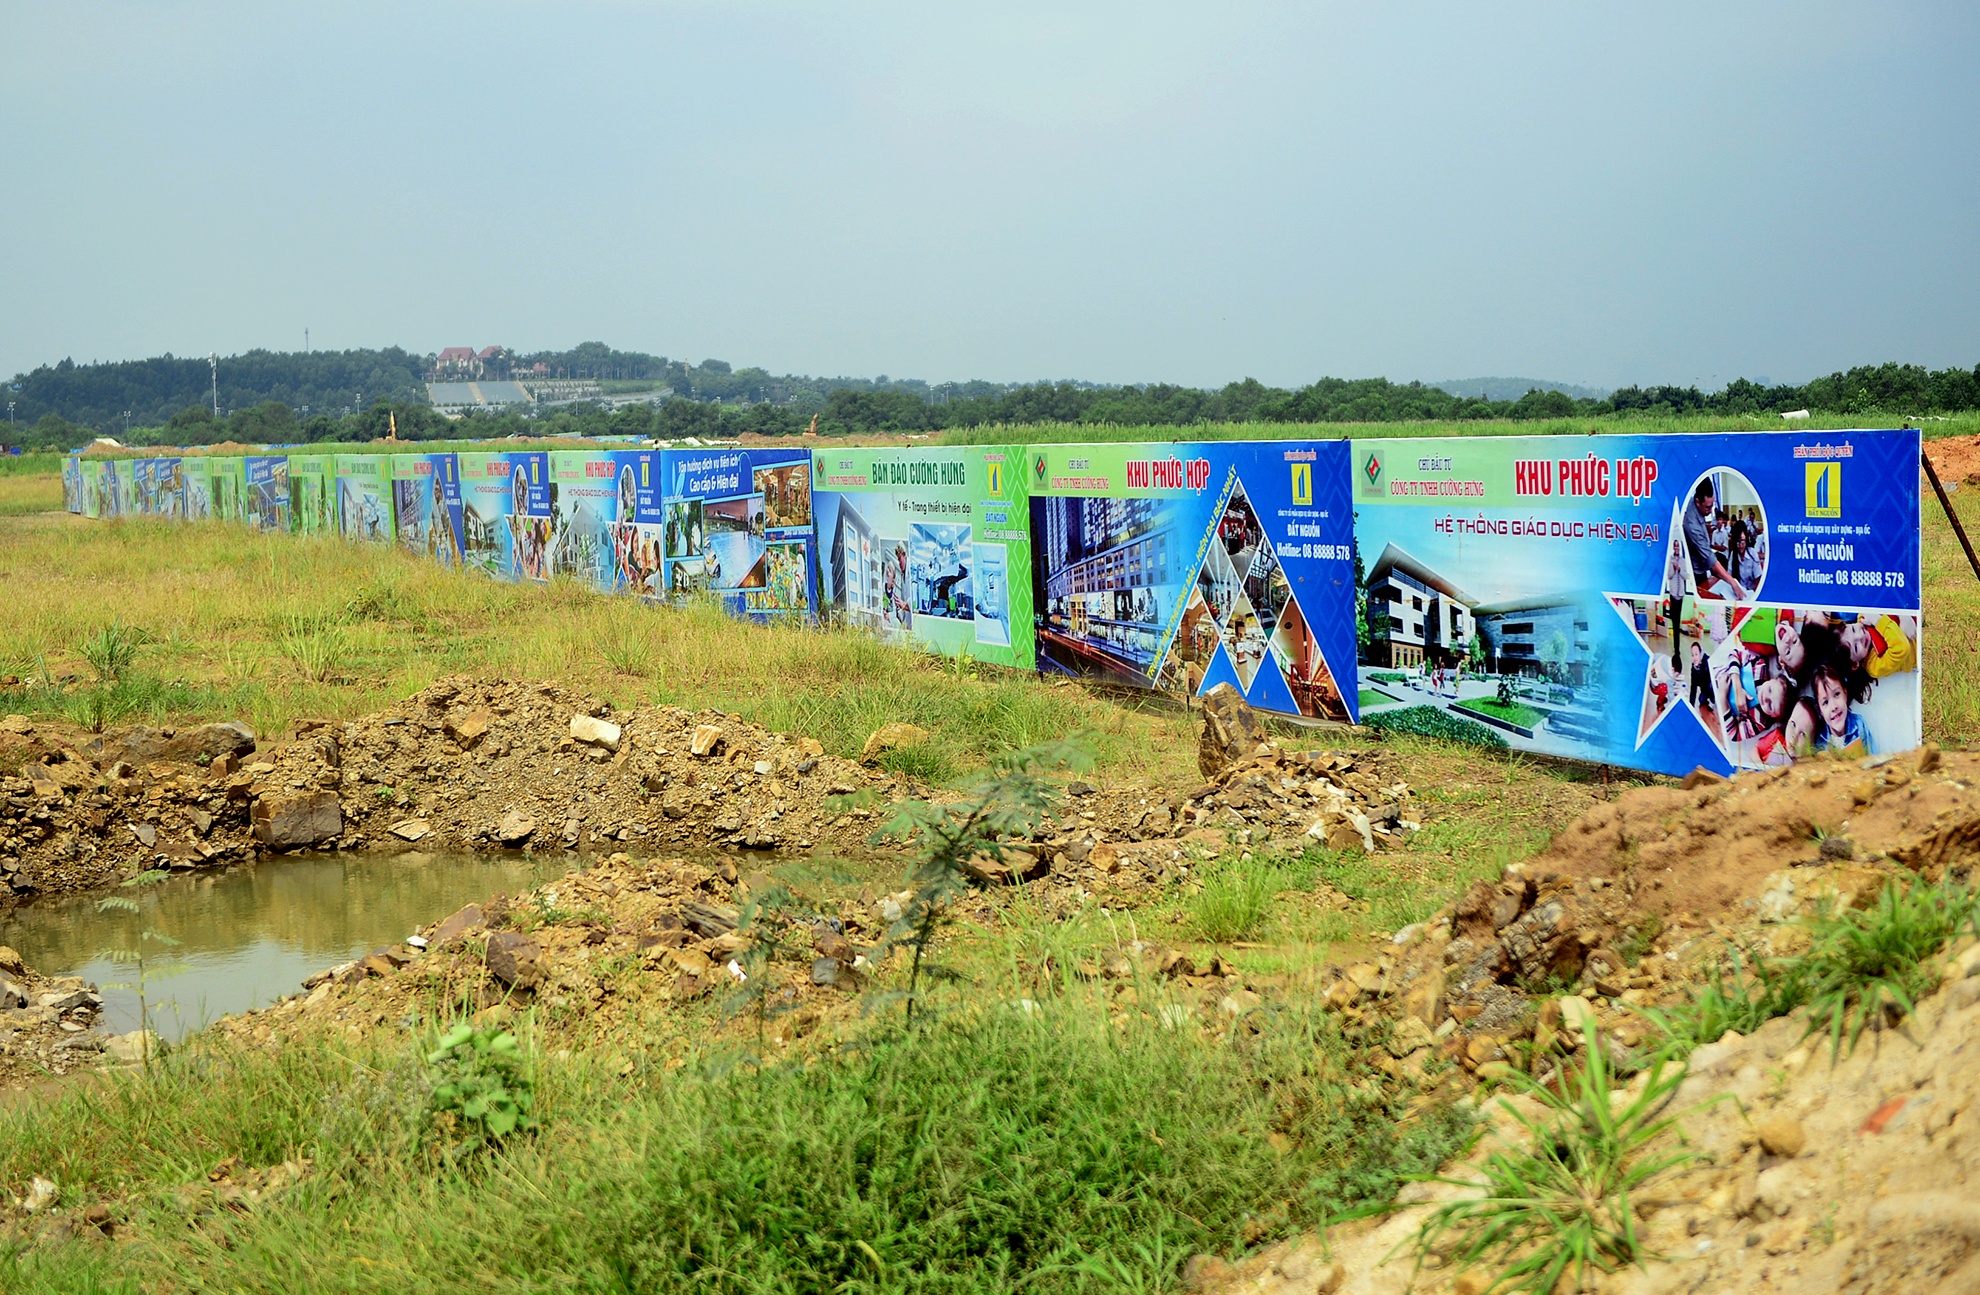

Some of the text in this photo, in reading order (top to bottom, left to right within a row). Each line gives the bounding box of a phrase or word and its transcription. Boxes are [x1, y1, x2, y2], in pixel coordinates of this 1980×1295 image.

[872, 457, 966, 486] BÁN ĐẢO CƯỜNG HƯNG
[1126, 455, 1210, 495] KHU PHỨC HỢP
[1515, 452, 1658, 506] KHU PHỨC HỢP
[690, 478, 700, 492] Cao
[701, 473, 711, 494] cấp
[717, 474, 729, 493] Hiện
[730, 473, 738, 492] đại
[1390, 478, 1484, 496] CÔNG TY TNHH CƯỜNG HƯNG
[898, 501, 902, 512] Y
[912, 501, 926, 515] Trang
[928, 500, 940, 512] thiết
[941, 502, 947, 516] bị
[948, 502, 960, 516] hiện
[961, 502, 972, 517] đại
[1434, 512, 1660, 546] HỆ THỐNG GIÁO DỤC HIỆN ĐẠI
[1277, 542, 1351, 561] Hotline: 08 88888 578
[1794, 536, 1854, 561] ĐẤT NGUỒN
[1799, 568, 1905, 588] Hotline: 08 88888 578
